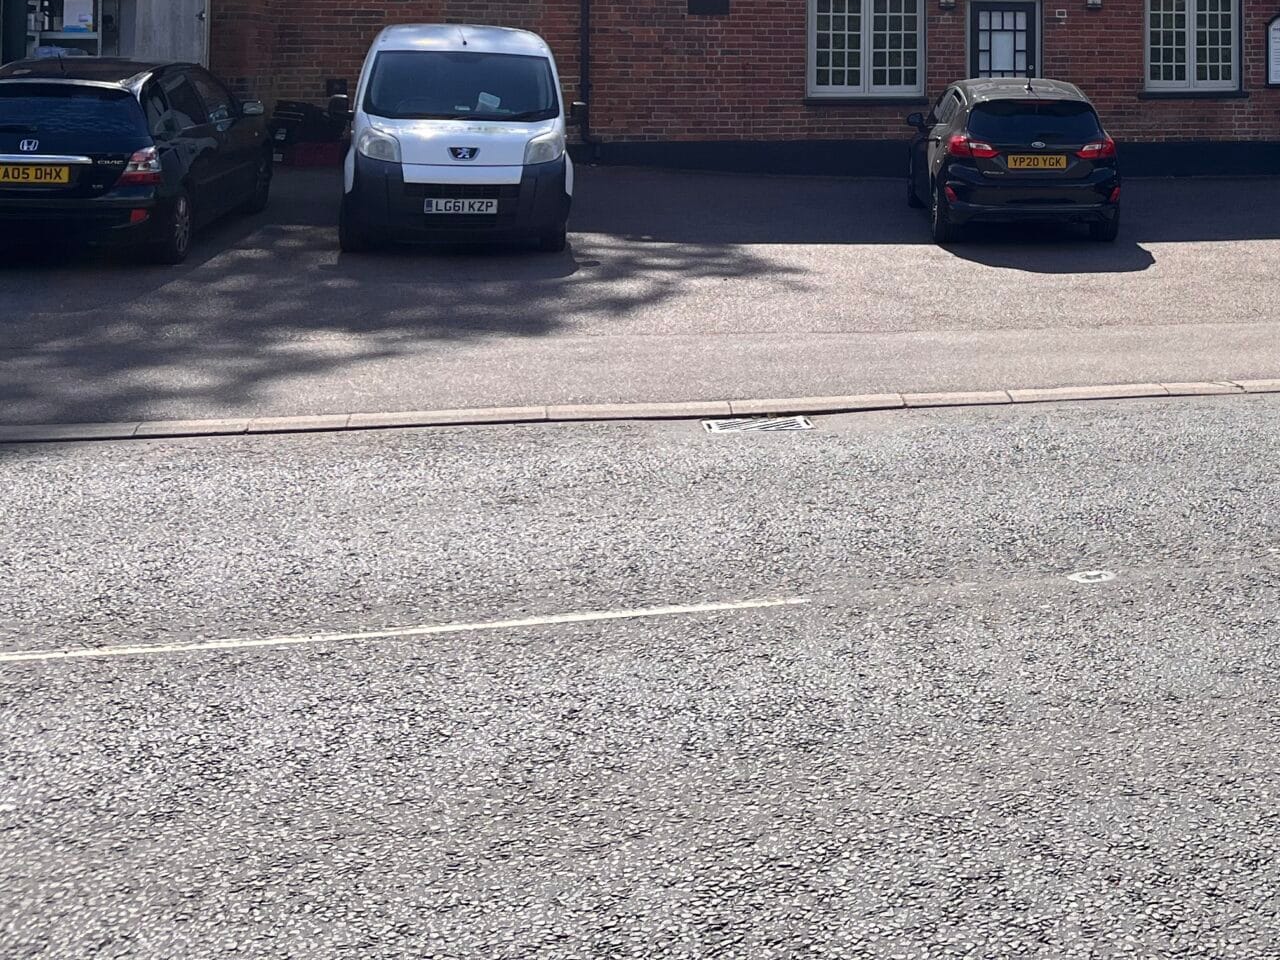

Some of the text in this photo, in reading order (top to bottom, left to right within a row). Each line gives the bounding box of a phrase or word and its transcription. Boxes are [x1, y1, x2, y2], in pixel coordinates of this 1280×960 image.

[1012, 156, 1062, 167] YP20 YGK
[0, 167, 63, 181] A05 DHX
[435, 200, 494, 212] LG61 KZP
